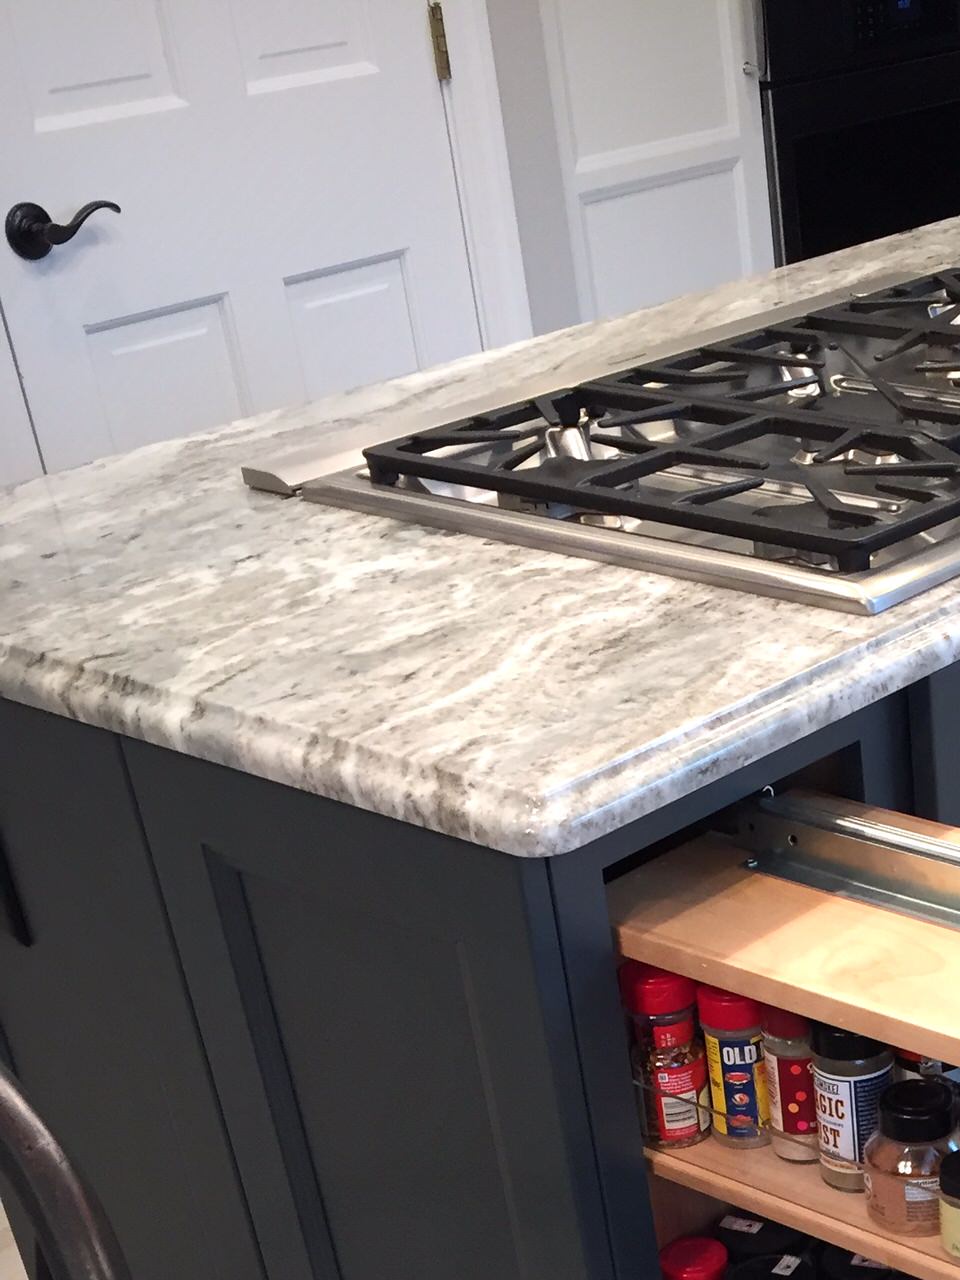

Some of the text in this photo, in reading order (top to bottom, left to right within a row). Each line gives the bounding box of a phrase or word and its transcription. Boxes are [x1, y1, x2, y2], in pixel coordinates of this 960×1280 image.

[722, 1044, 758, 1066] OLD
[817, 1092, 846, 1120] GIC
[821, 1123, 841, 1149] ST
